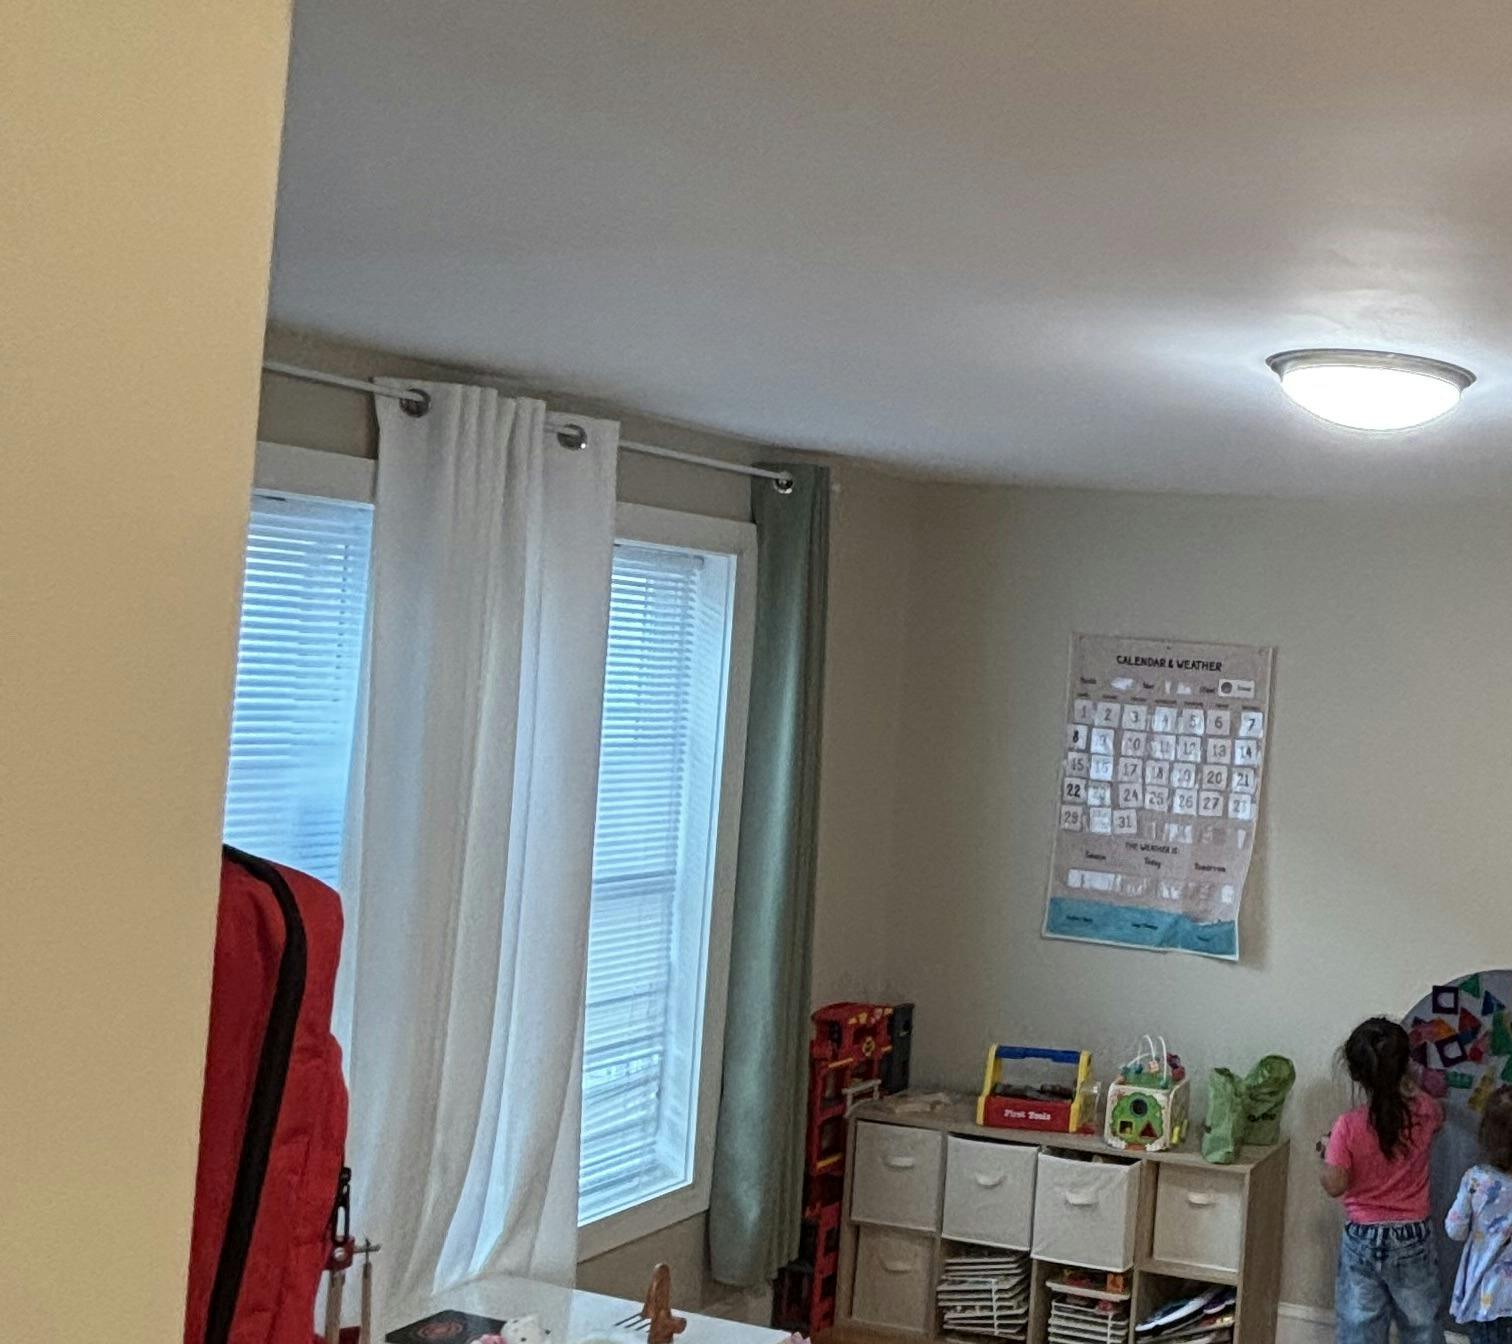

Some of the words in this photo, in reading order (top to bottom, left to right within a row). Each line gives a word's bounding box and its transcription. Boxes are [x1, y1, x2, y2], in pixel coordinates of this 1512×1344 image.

[1116, 655, 1166, 668] CALENDAR
[1176, 660, 1223, 672] WEATHER
[1104, 708, 1112, 721] 2
[1130, 710, 1139, 723] 3
[1214, 716, 1223, 729] 6
[1246, 717, 1256, 732] 7
[1072, 730, 1079, 743] 8
[1212, 745, 1226, 757] 13
[1240, 746, 1252, 759] 14
[1071, 757, 1085, 772] 15
[1123, 763, 1138, 777] 17
[1207, 770, 1223, 785] 20
[1236, 773, 1249, 787] 21
[1066, 782, 1081, 798] 22
[1123, 788, 1139, 802] 24
[1148, 791, 1164, 805] 25
[1178, 794, 1193, 809] 26
[1202, 797, 1220, 810] 27
[1118, 816, 1132, 829] 31
[1003, 1108, 1026, 1120] First
[1028, 1110, 1052, 1122] Tools
